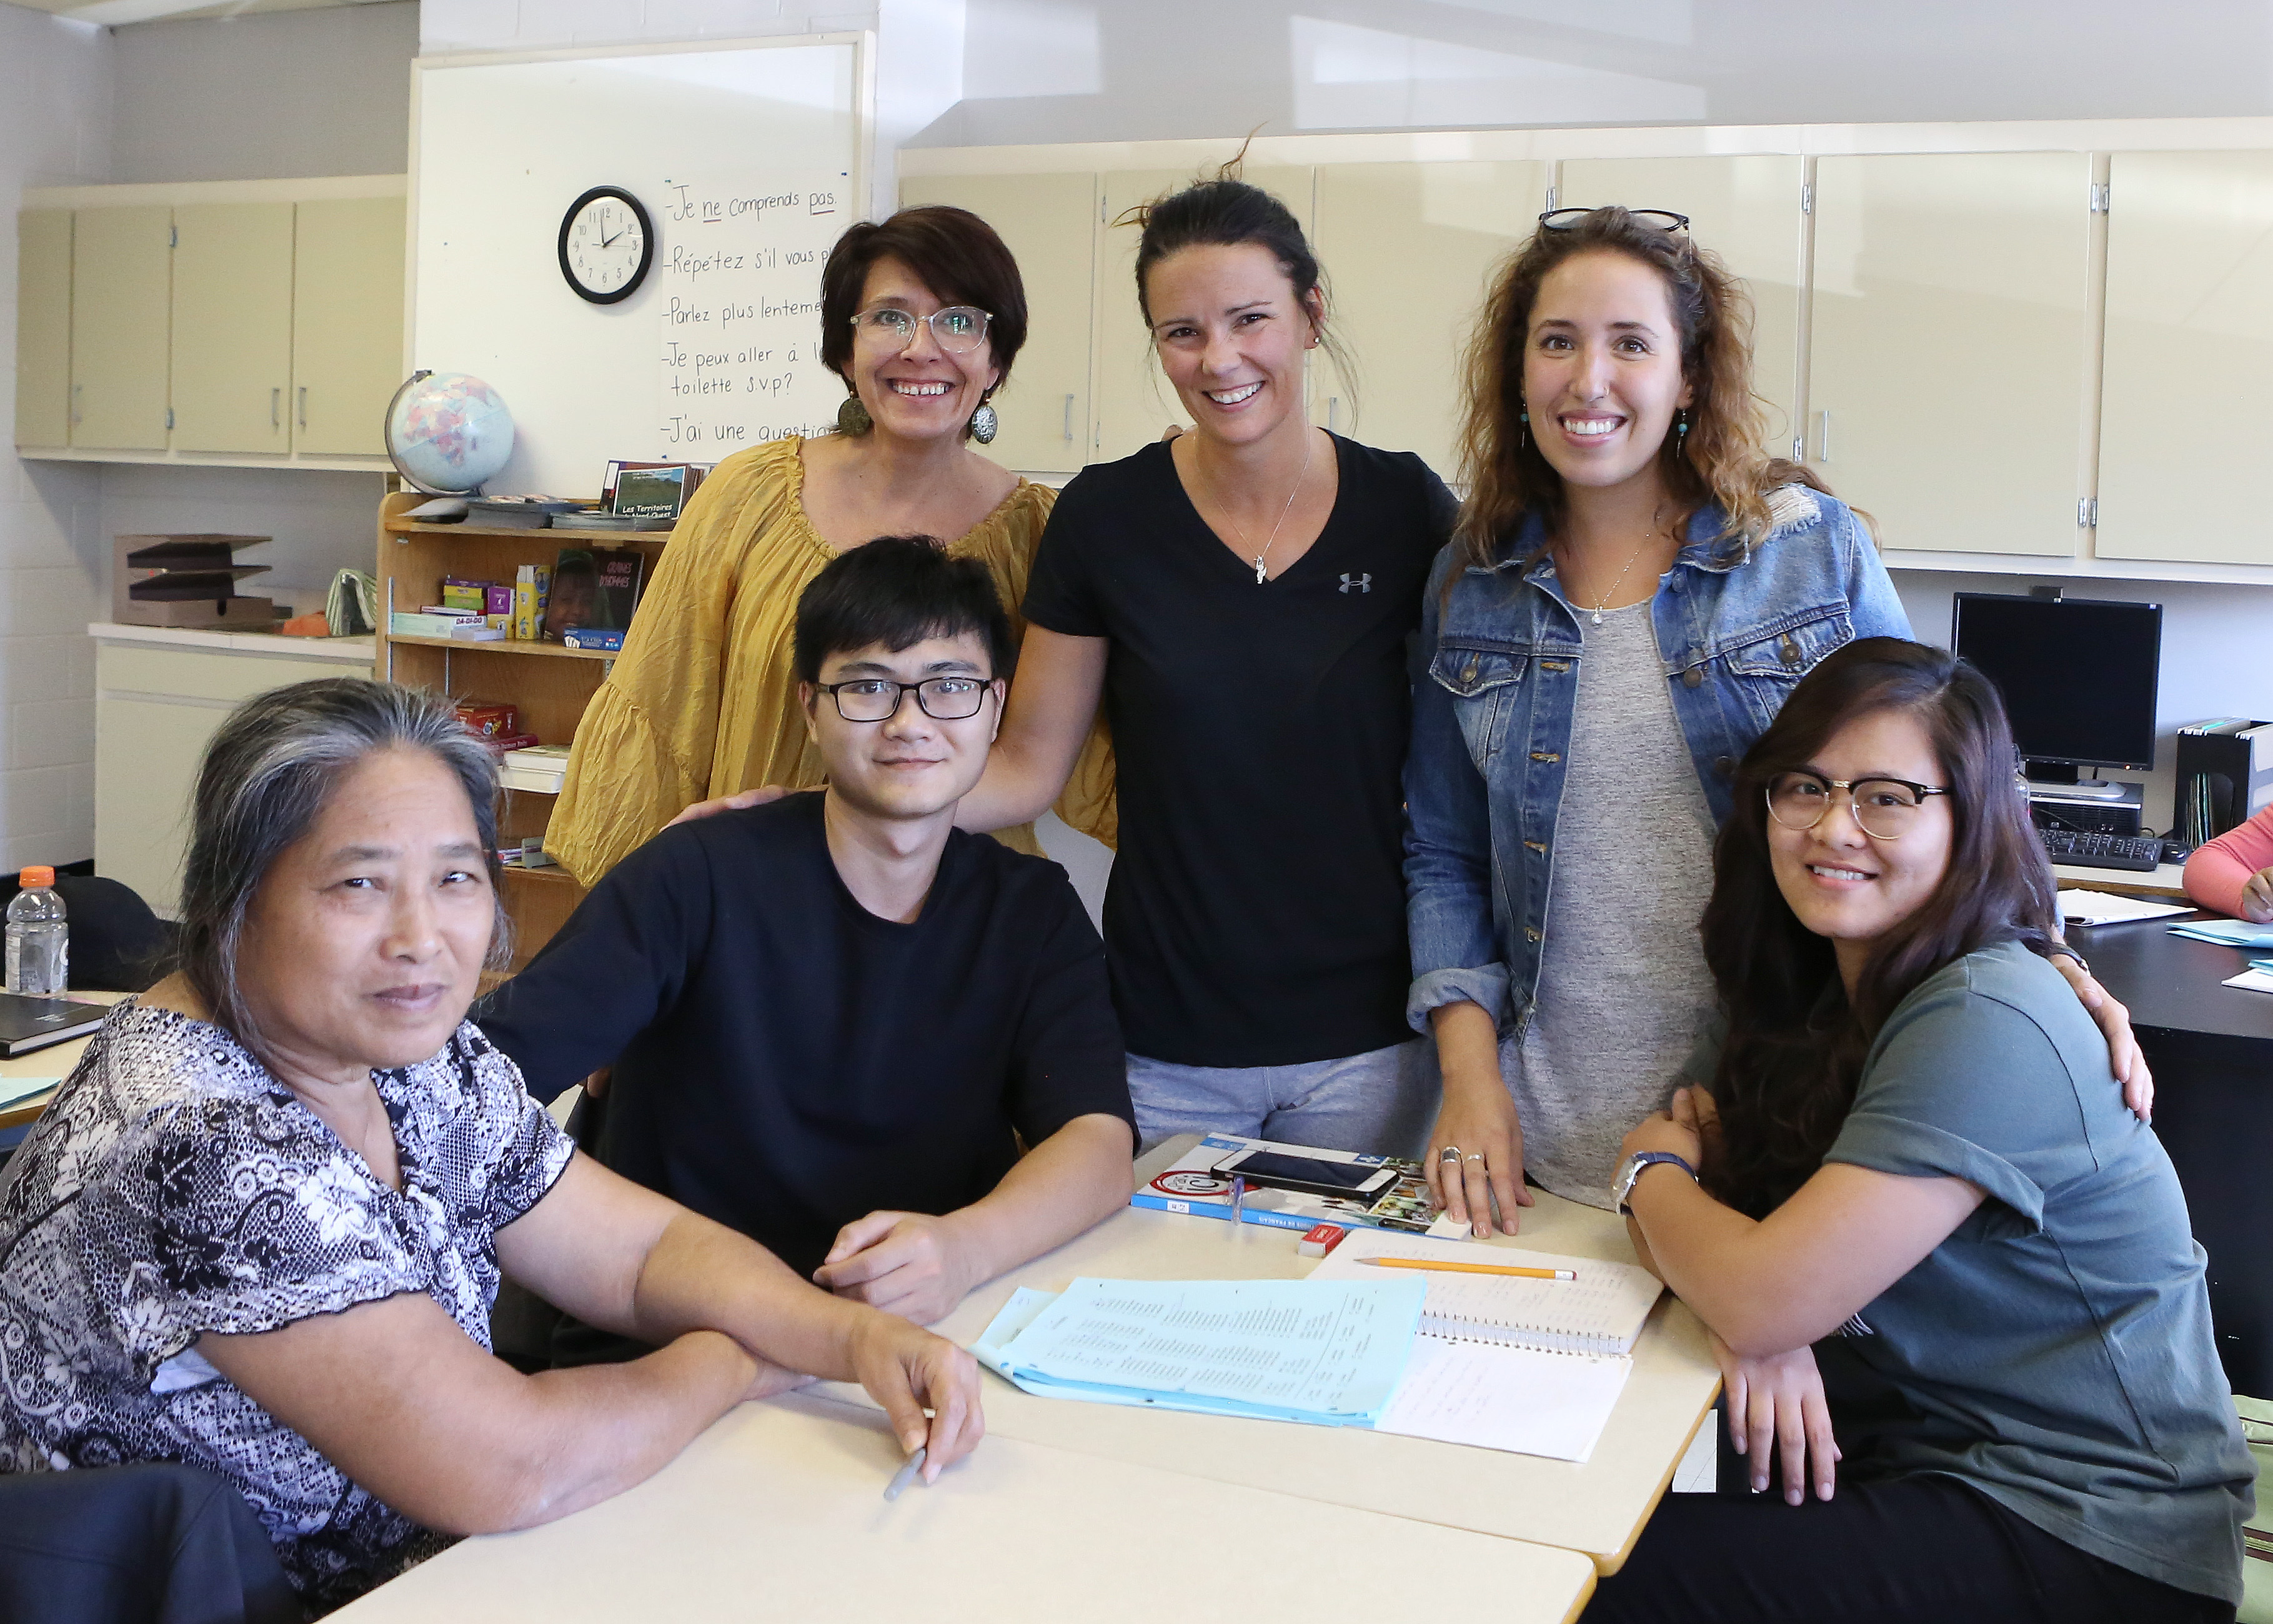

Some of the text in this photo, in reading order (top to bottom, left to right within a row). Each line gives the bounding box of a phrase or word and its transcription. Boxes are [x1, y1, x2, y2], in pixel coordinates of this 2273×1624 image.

[703, 201, 722, 218] ne
[810, 192, 837, 216] pas.
[589, 211, 596, 224] 11
[602, 207, 611, 218] 12
[619, 212, 623, 224] 1
[579, 225, 587, 236] 10
[627, 224, 634, 234] 2
[574, 241, 580, 252] 9
[632, 240, 637, 251] 3
[578, 256, 584, 267] 8
[628, 255, 633, 266] 4
[755, 247, 776, 269] s'il
[785, 250, 814, 265] vous
[588, 267, 593, 278] 7
[602, 272, 607, 284] 6
[617, 267, 622, 279] 5
[722, 302, 754, 330] plus
[695, 353, 730, 376] peux
[738, 346, 773, 363] aller
[670, 375, 732, 397] toilette
[714, 425, 745, 441] une
[636, 504, 673, 512] Territoires
